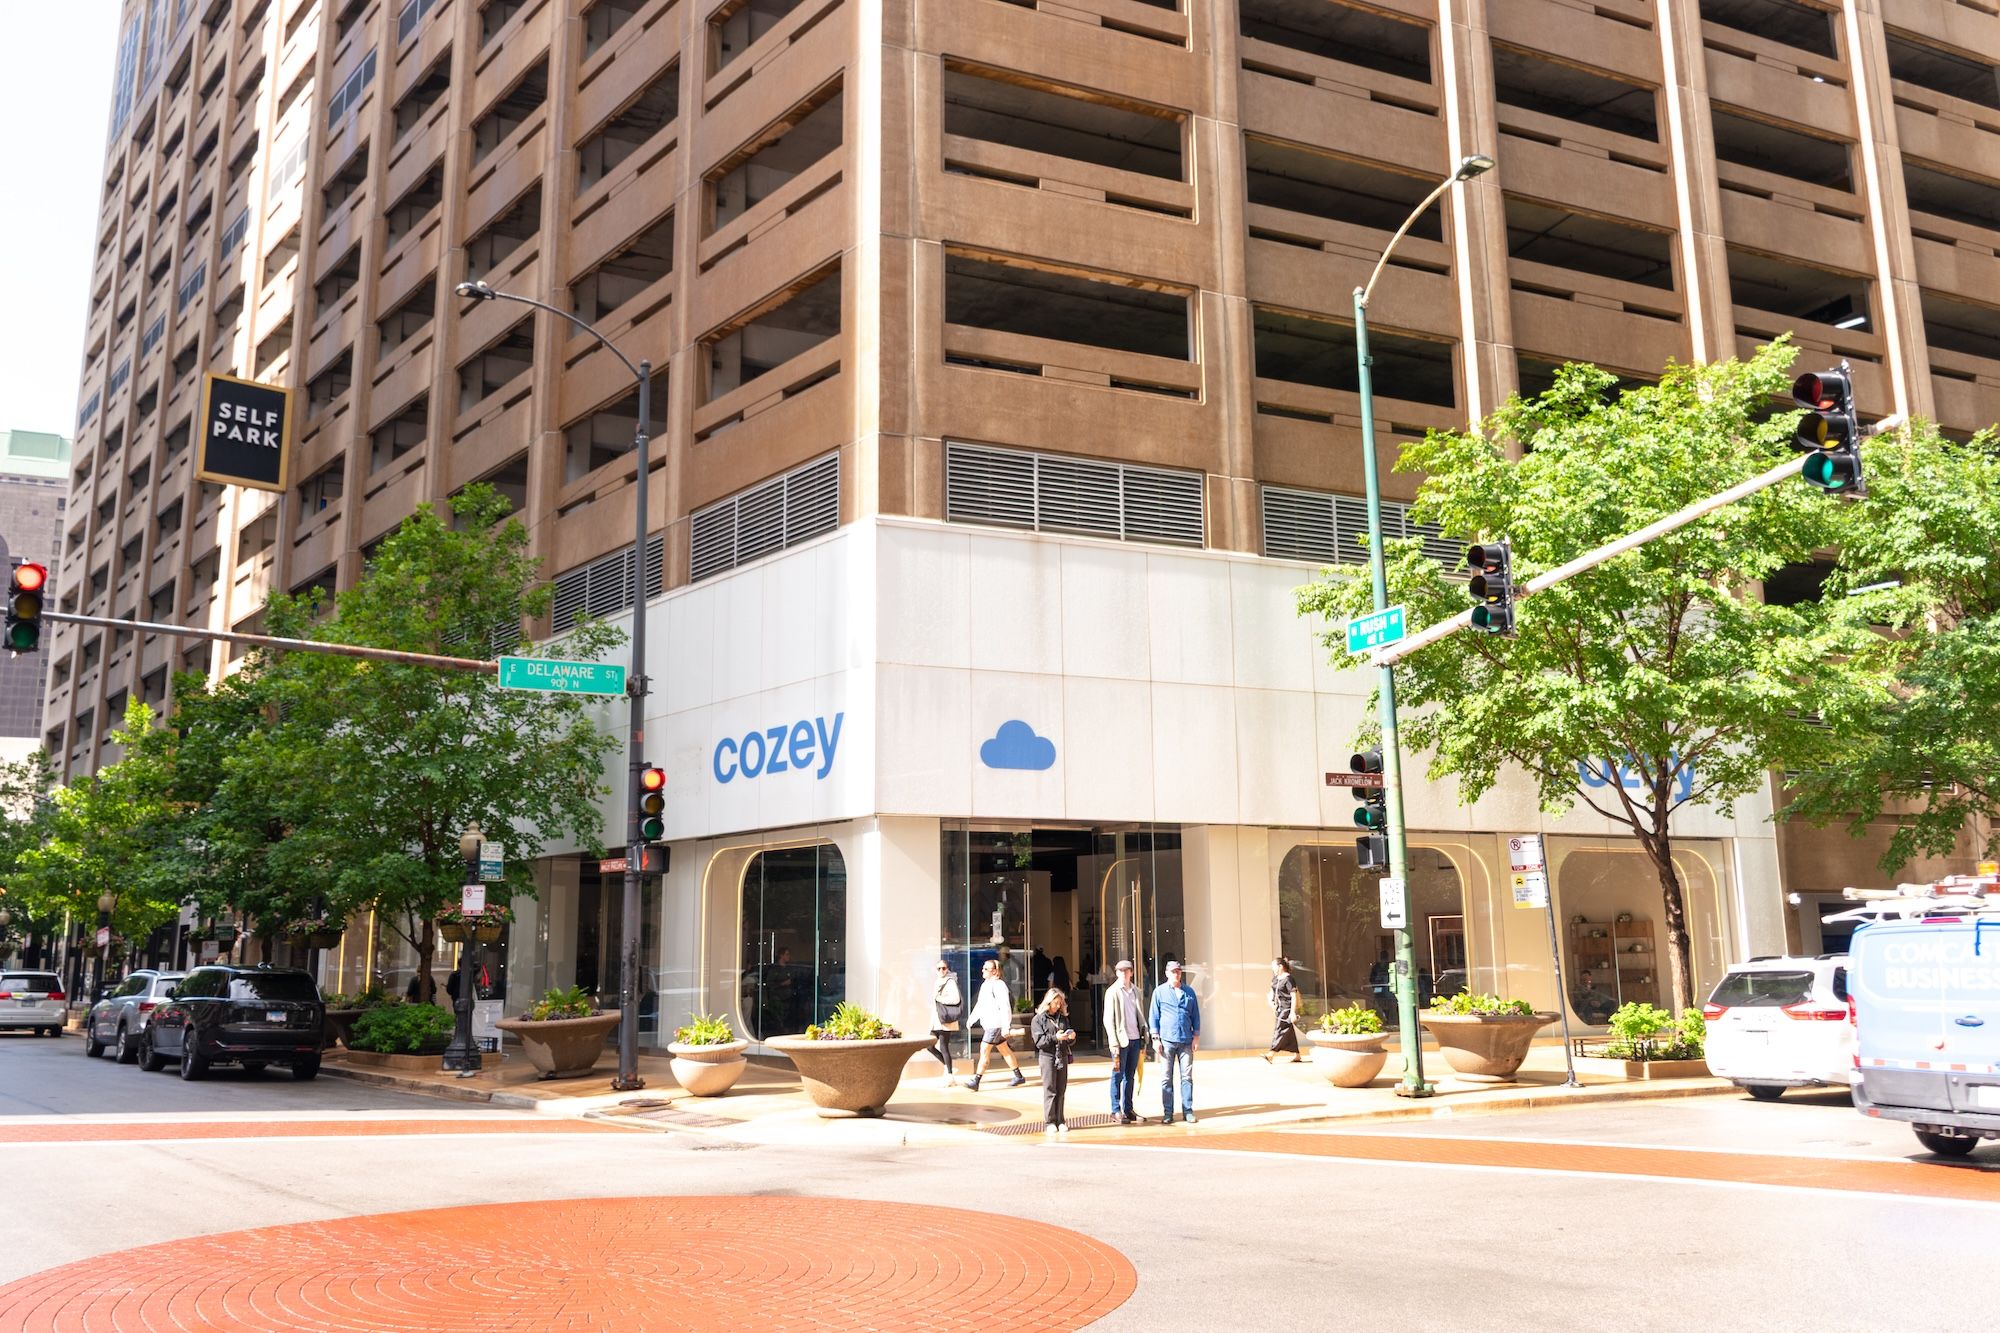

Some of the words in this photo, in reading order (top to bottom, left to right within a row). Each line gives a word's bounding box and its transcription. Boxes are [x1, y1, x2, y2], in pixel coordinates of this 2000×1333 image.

[218, 402, 278, 428] SELF
[213, 421, 279, 448] PARK
[1360, 615, 1387, 636] RUSH
[510, 664, 516, 673] E
[527, 663, 595, 680] DELAWARE
[605, 671, 615, 679] ST
[572, 680, 579, 688] N
[713, 712, 845, 783] cozey
